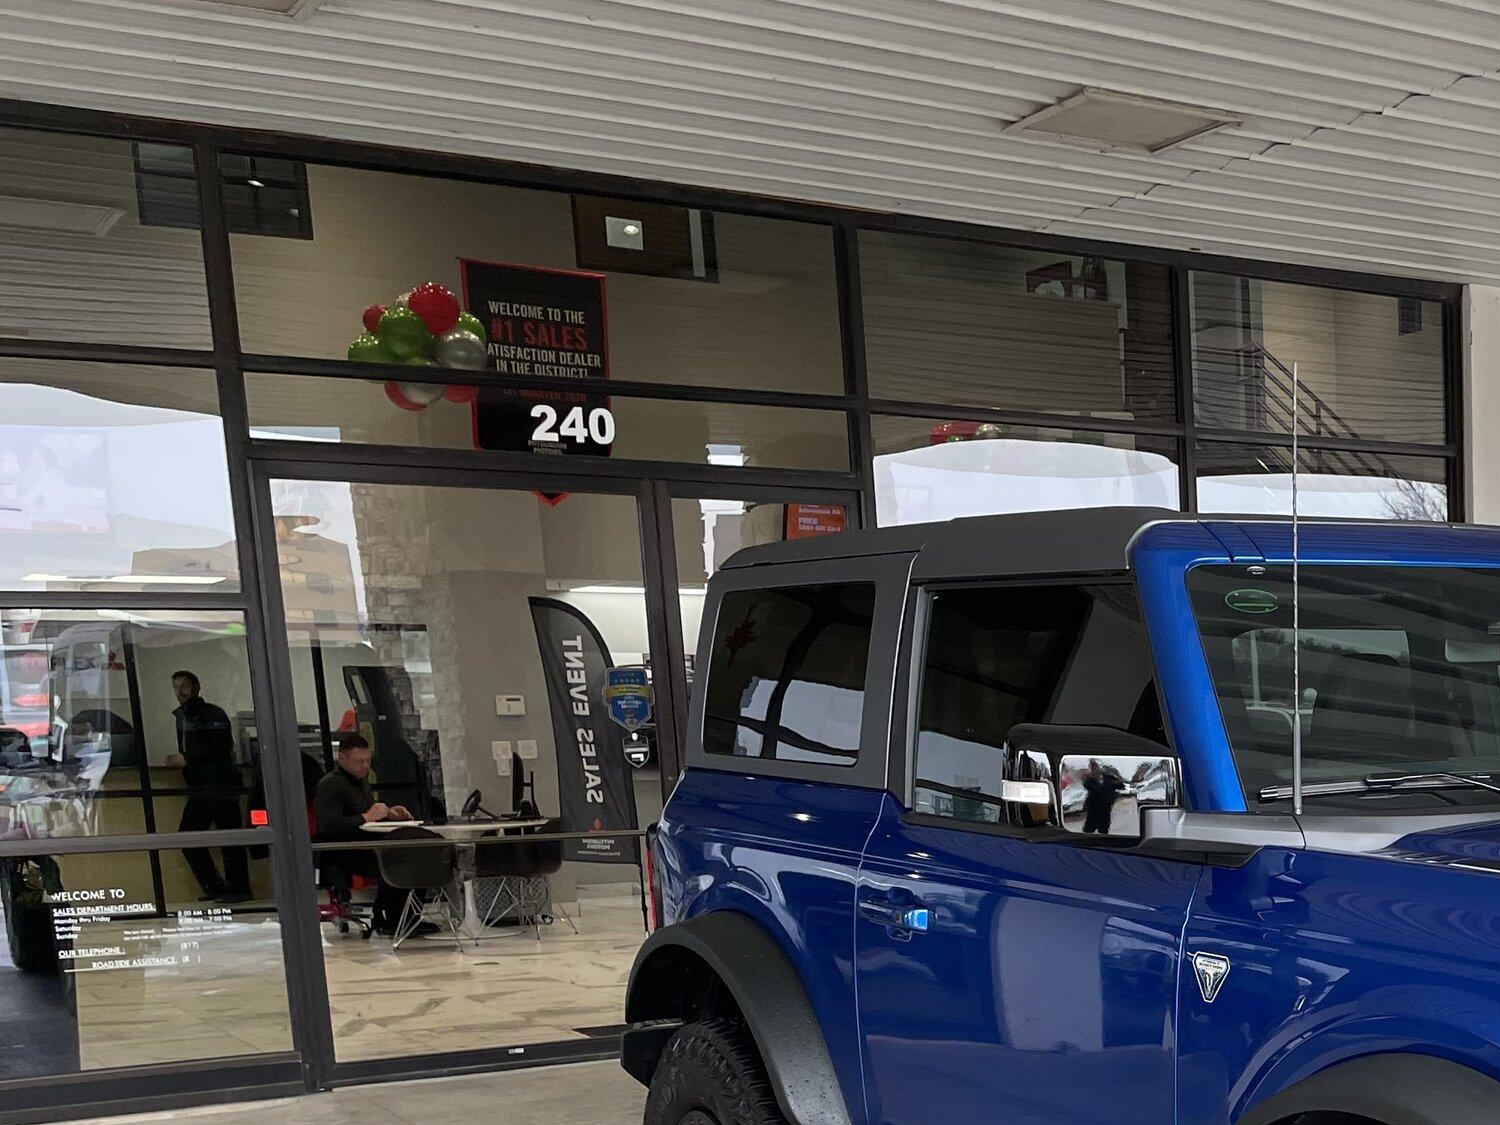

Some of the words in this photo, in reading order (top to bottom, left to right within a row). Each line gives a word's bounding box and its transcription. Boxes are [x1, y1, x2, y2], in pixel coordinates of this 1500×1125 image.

[488, 300, 544, 320] WELCOME
[548, 307, 561, 322] TO
[564, 309, 585, 324] THE
[489, 318, 513, 342] #1
[523, 322, 587, 349] SALES
[487, 342, 556, 364] ATISFACTION
[559, 351, 601, 367] DEALER
[496, 359, 508, 373] IN
[510, 360, 530, 375] THE
[530, 404, 616, 445] 240
[51, 890, 105, 902] WELCOME
[109, 888, 125, 899] TO
[53, 906, 76, 916] SALES
[77, 904, 124, 915] DEPARTMENT
[58, 950, 76, 959] OUR
